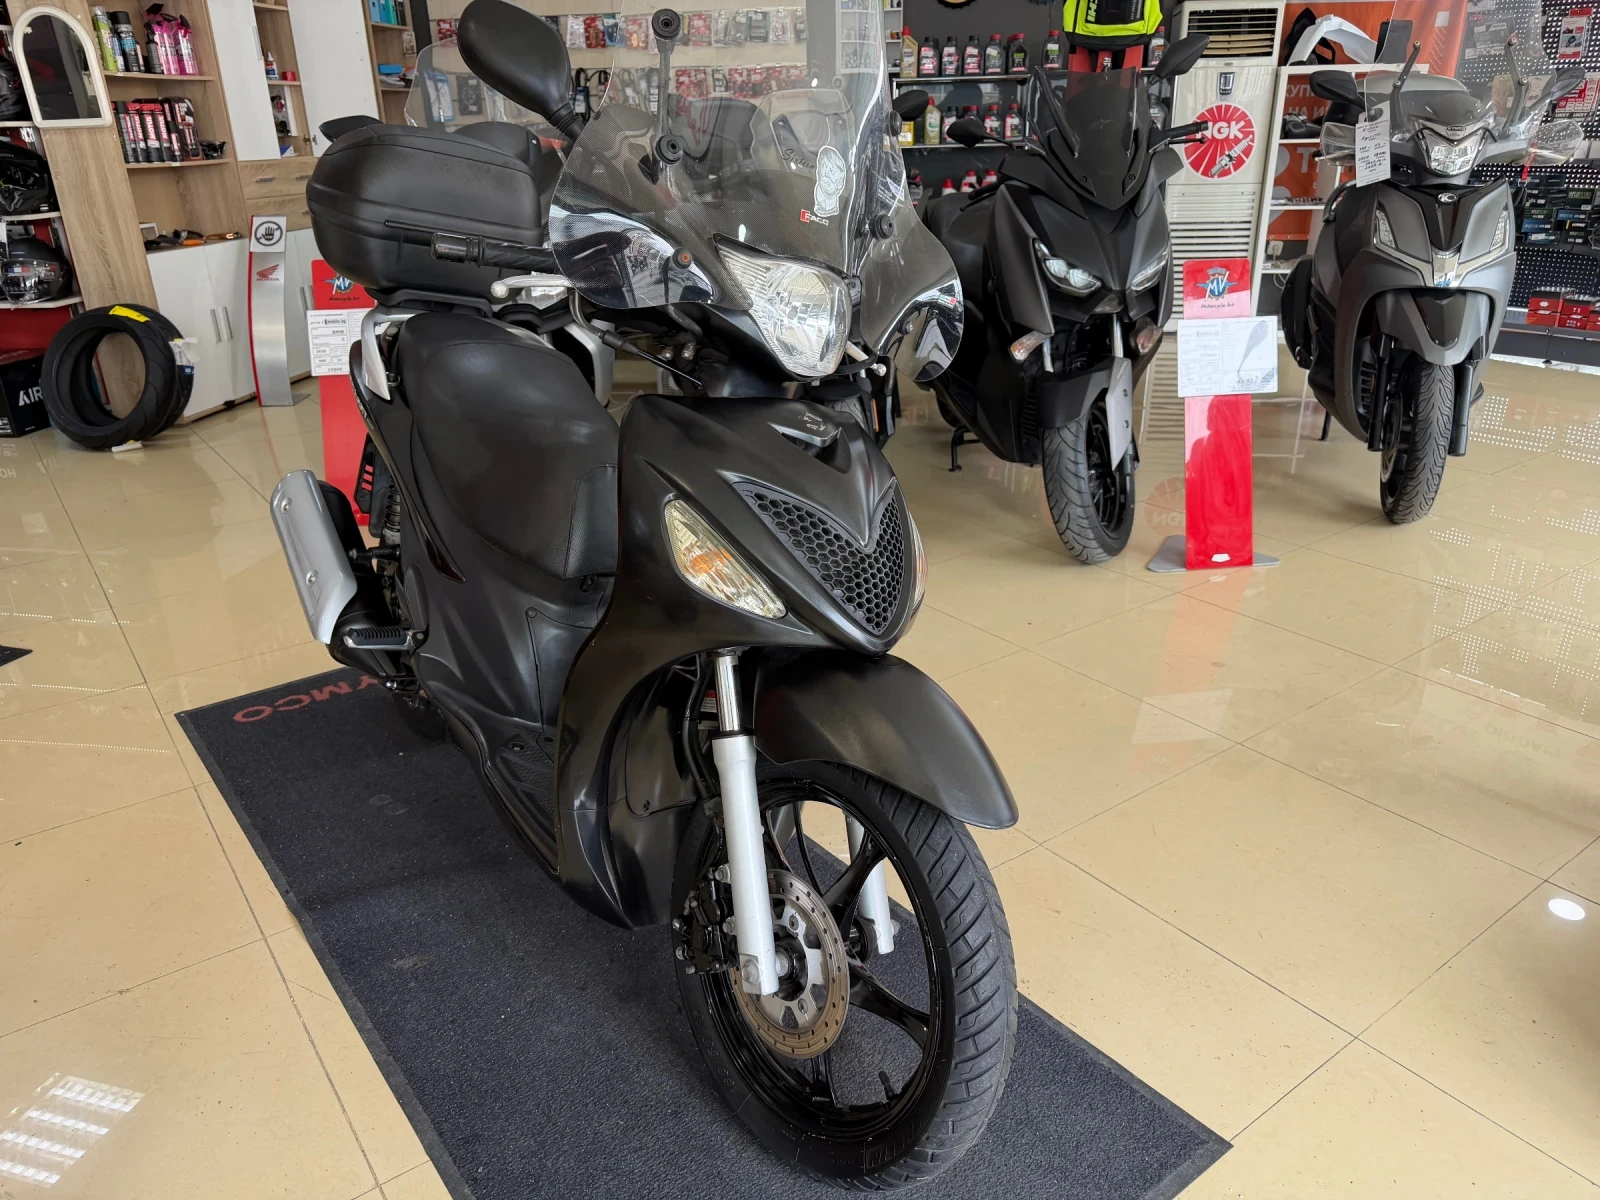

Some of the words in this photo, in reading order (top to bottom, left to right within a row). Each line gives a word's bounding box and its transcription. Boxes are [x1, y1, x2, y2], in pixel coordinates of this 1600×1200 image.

[1196, 120, 1245, 140] NGK
[781, 149, 815, 169] Sixteen
[332, 274, 354, 295] MV
[1205, 270, 1230, 300] MV
[232, 675, 379, 723] YMCO
